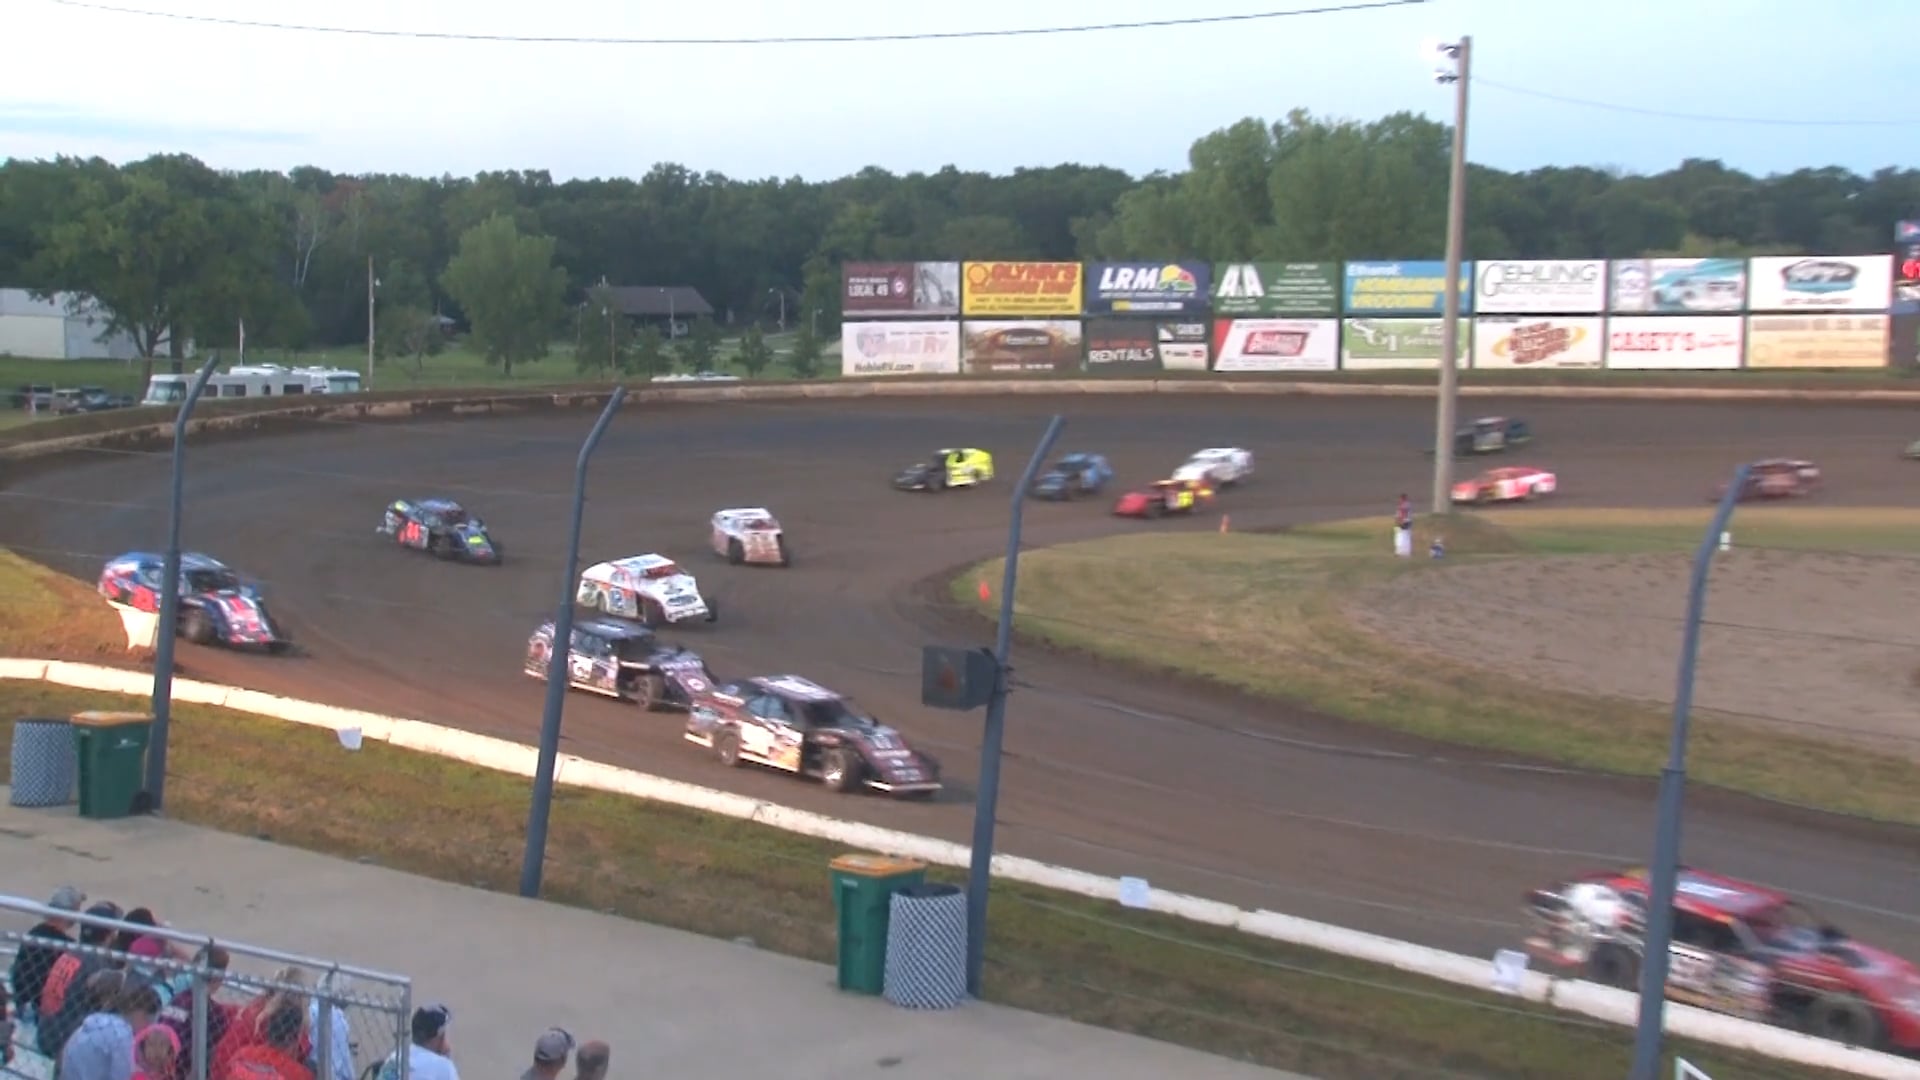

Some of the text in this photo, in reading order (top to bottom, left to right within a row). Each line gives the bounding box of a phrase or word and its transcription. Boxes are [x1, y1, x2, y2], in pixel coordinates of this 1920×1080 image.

[1098, 266, 1160, 290] LRM
[848, 284, 889, 297] LOCAL 49
[1611, 331, 1695, 352] CASEY'S
[1088, 347, 1155, 363] RENTALS
[854, 361, 914, 373] NobleRV.com
